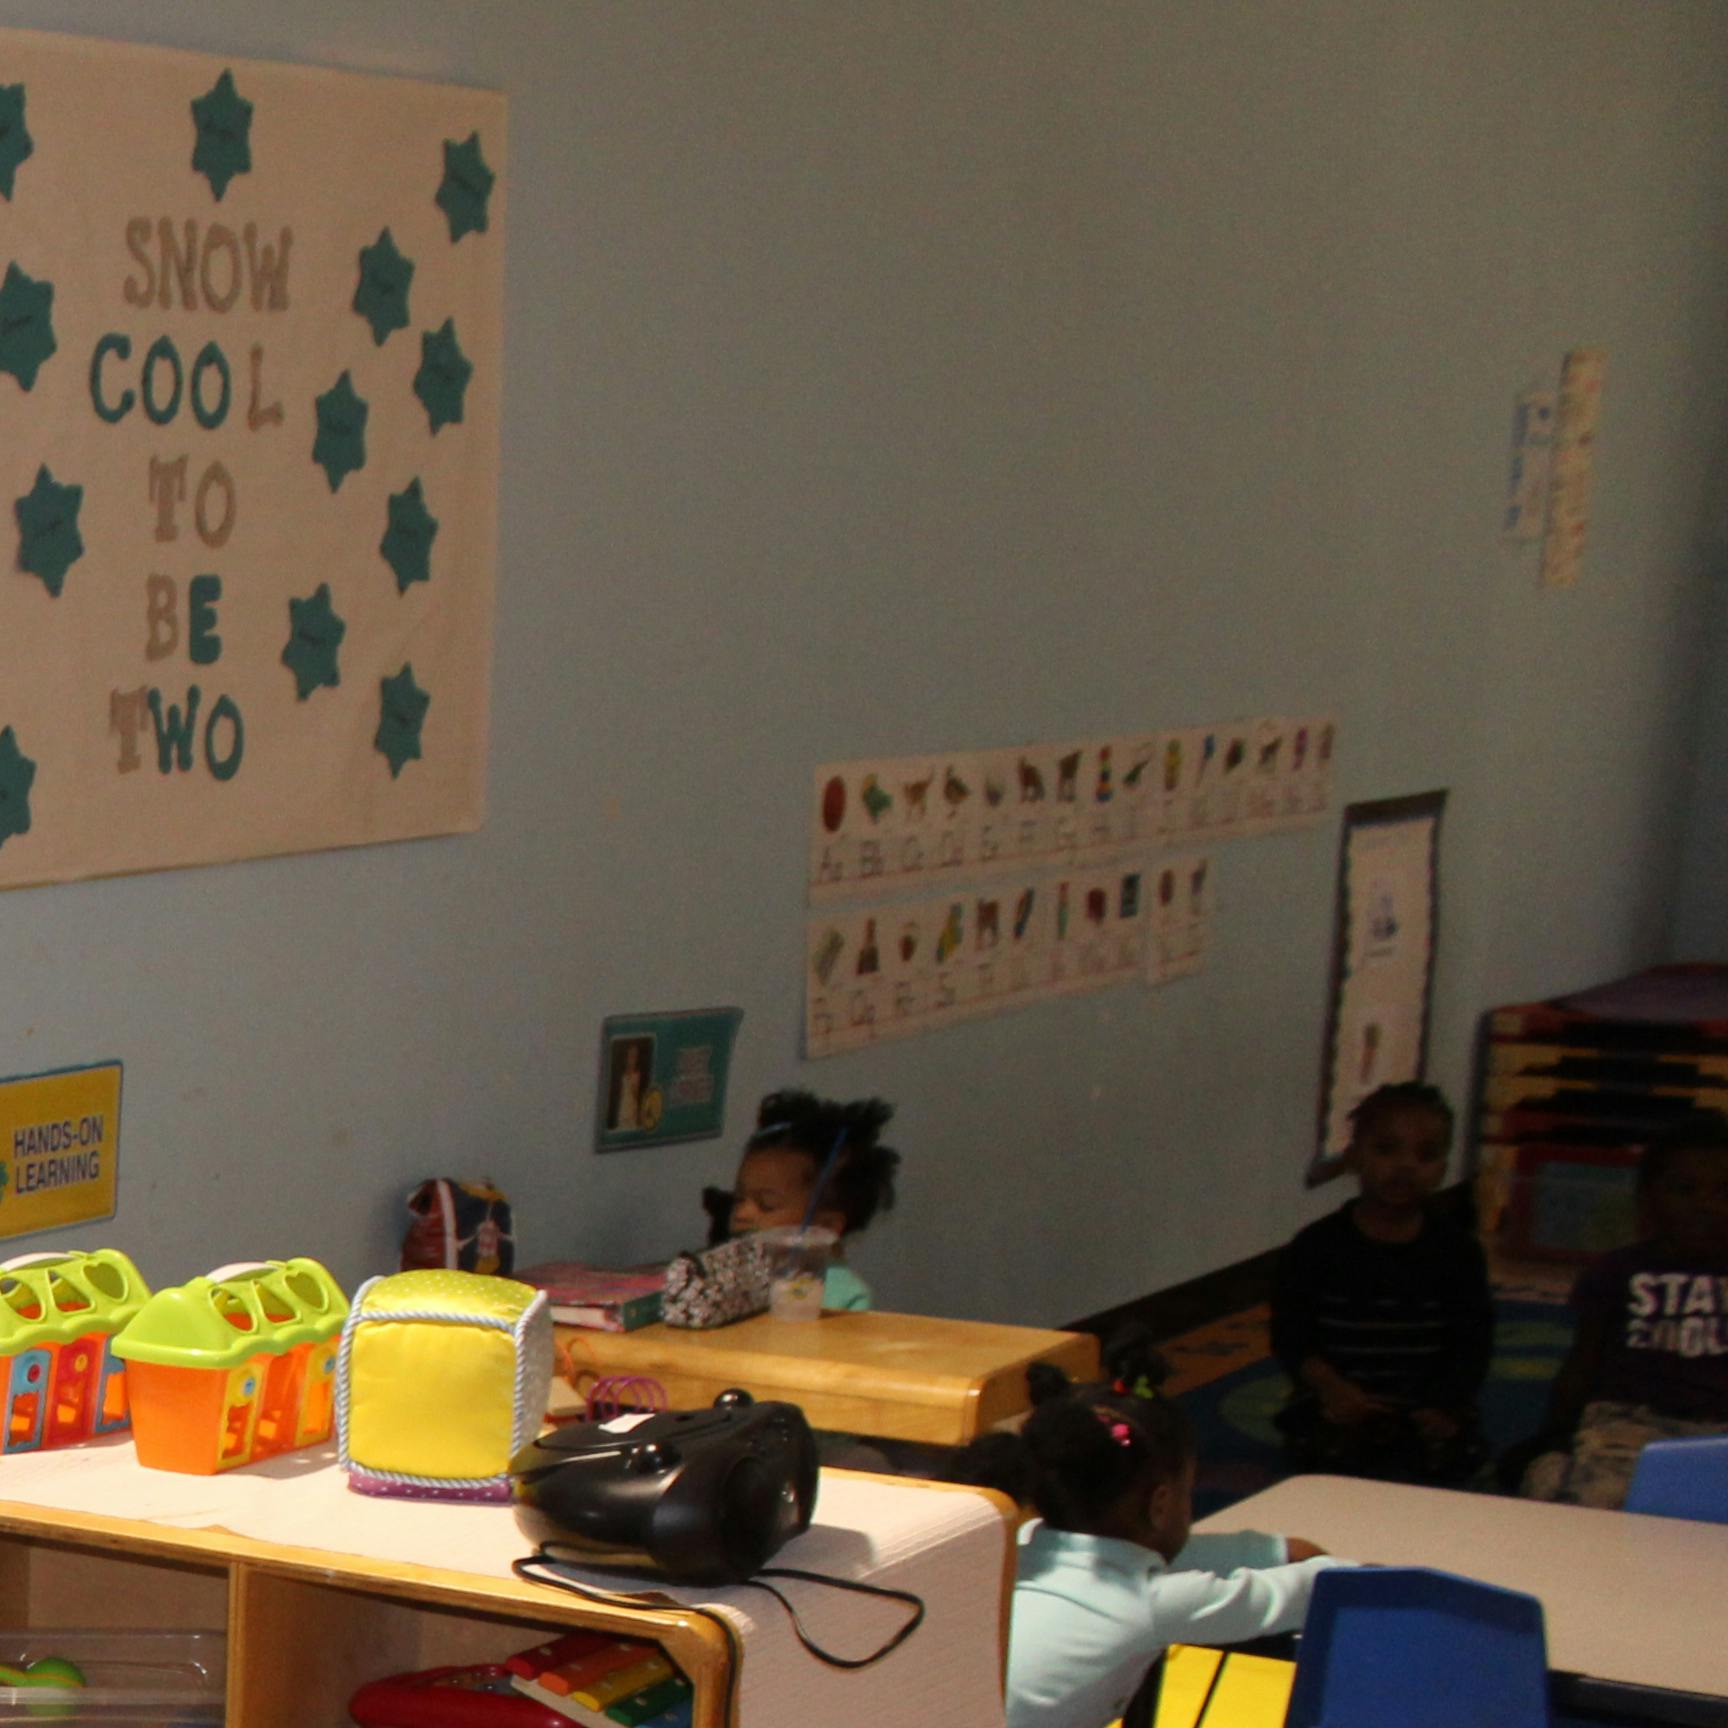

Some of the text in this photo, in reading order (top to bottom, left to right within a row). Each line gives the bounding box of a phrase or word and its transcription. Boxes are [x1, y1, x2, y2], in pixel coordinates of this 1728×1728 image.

[124, 216, 293, 313] SNOW
[91, 333, 284, 431] COOL
[149, 454, 236, 549] TO
[146, 573, 222, 664] BE
[110, 685, 244, 780] TWO
[13, 1115, 104, 1159] HANDS-ON
[15, 1151, 100, 1194] LEARNING
